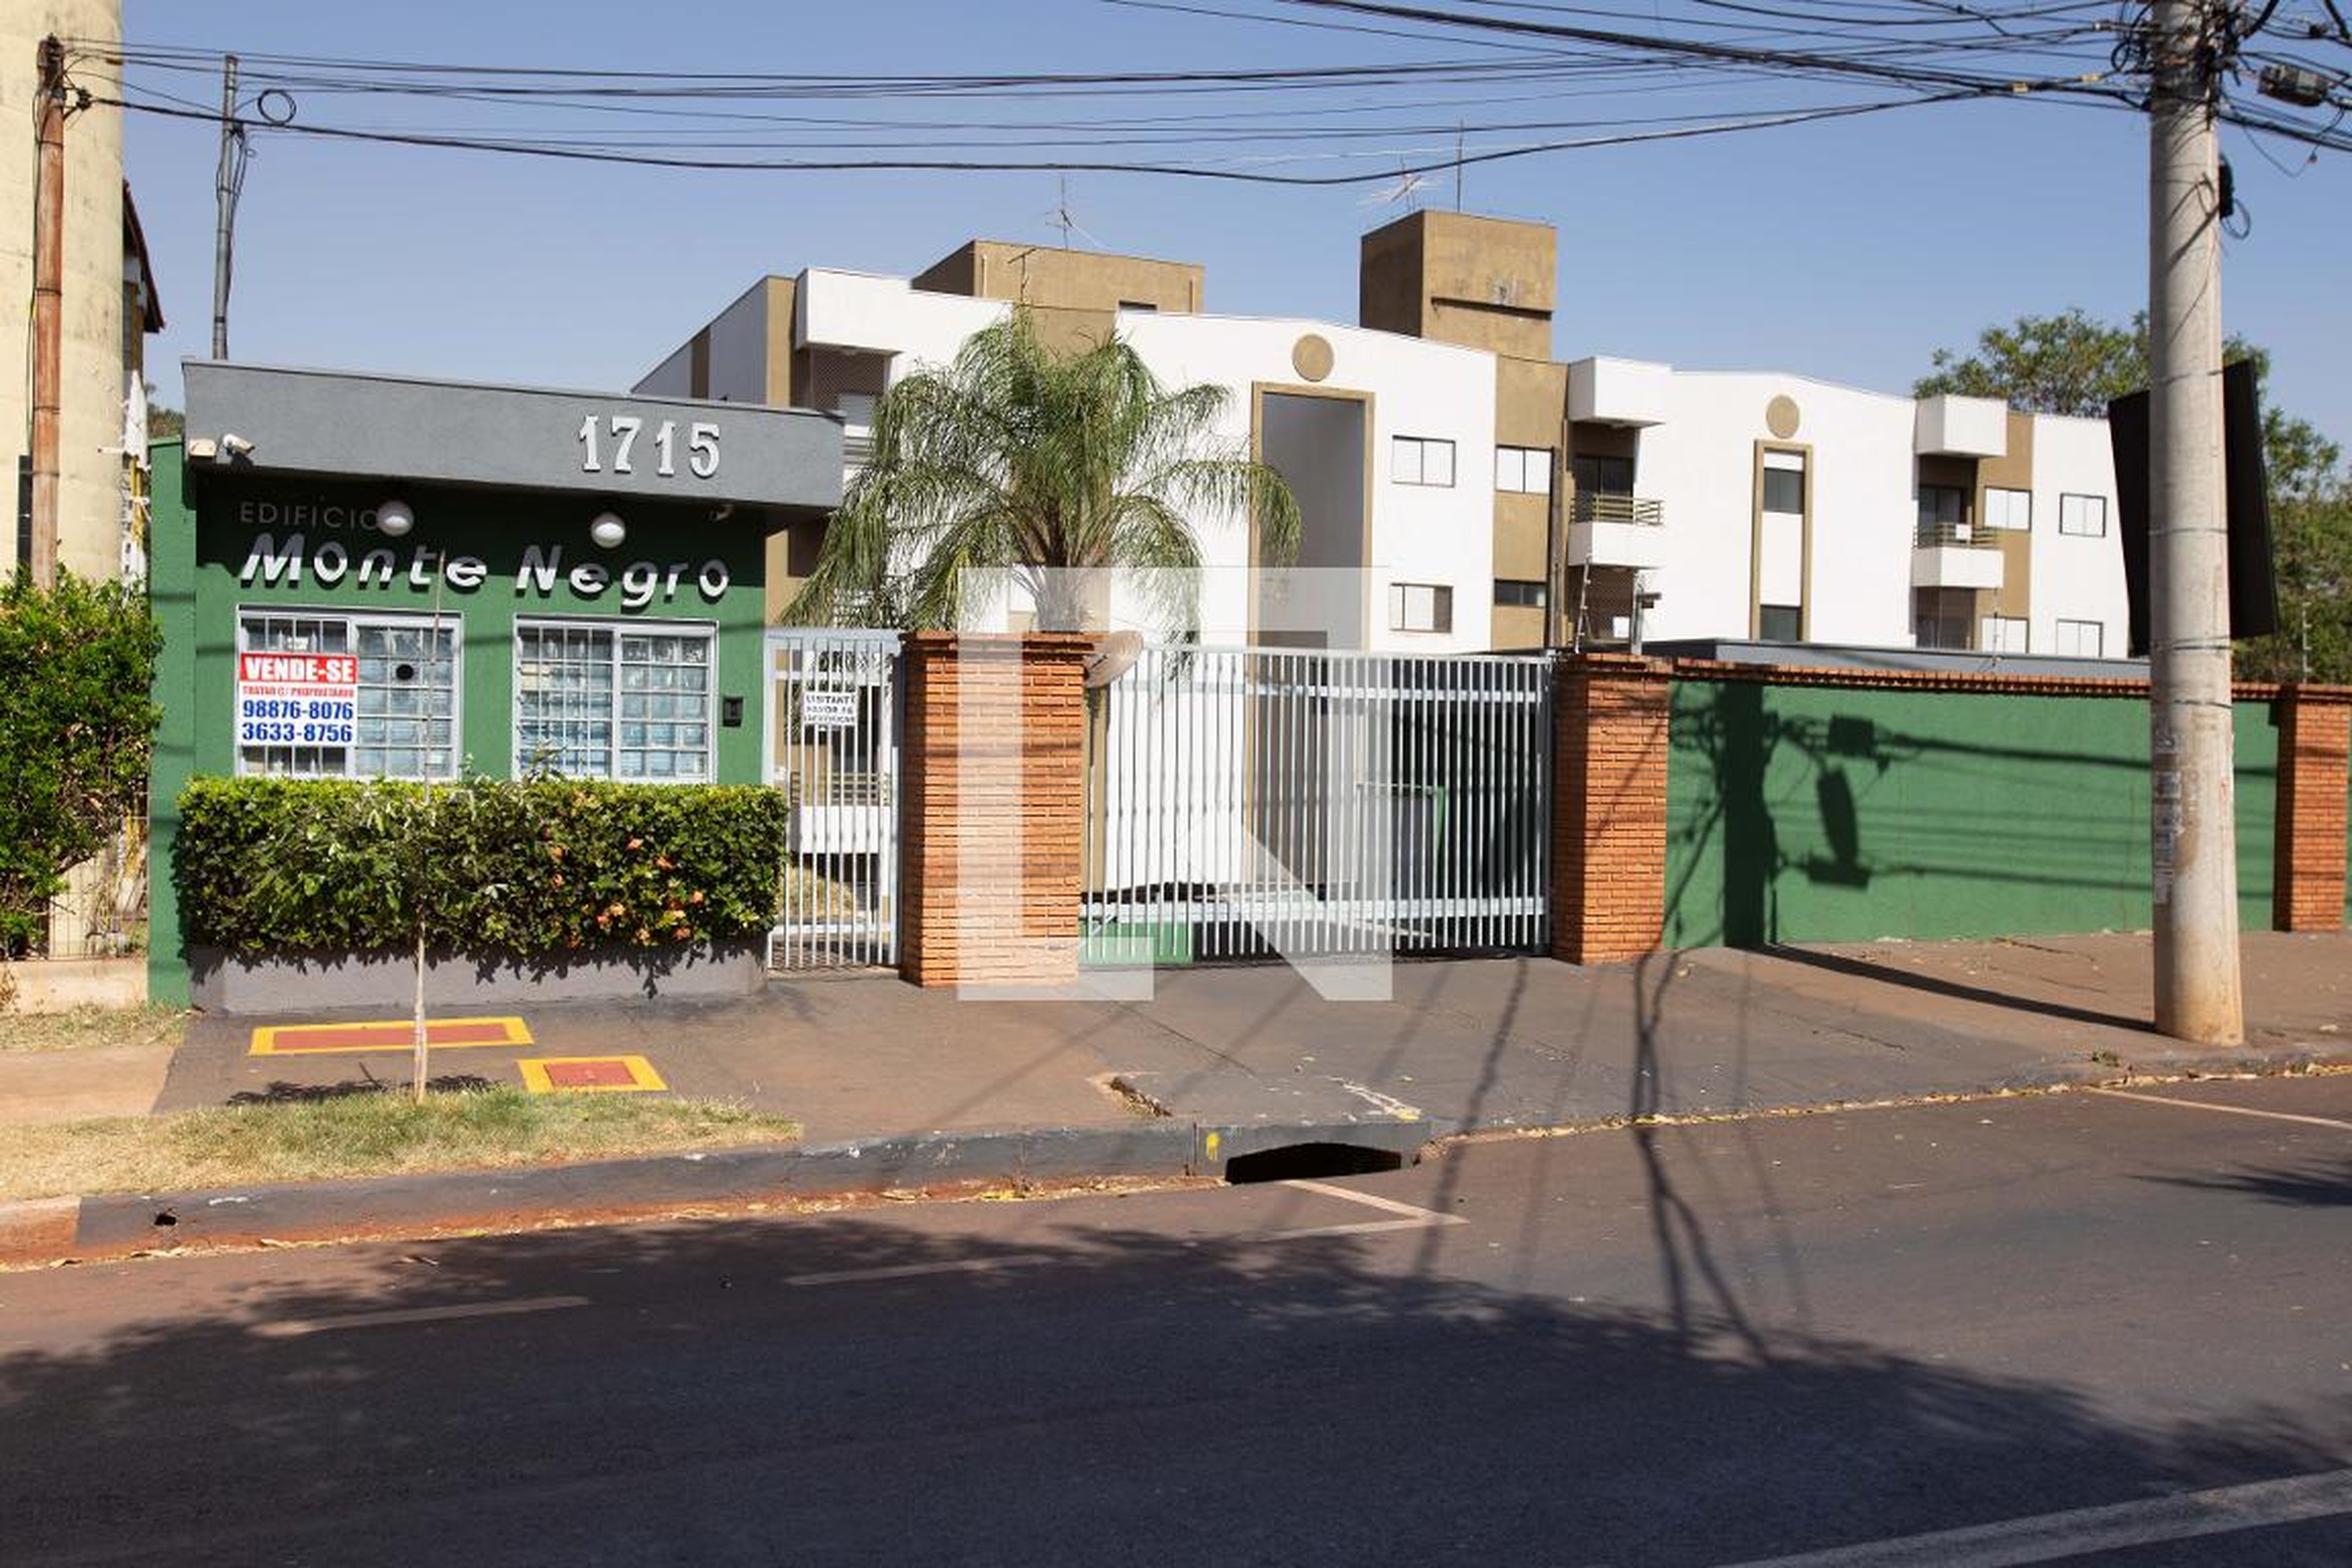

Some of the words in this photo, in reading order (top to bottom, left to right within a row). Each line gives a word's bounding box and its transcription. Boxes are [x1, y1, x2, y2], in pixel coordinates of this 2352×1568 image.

[579, 415, 720, 478] 1715
[241, 533, 488, 589] Monte
[516, 545, 729, 608] Negro
[245, 657, 353, 682] VENDE-SE
[243, 700, 353, 720] 98876-8076
[243, 722, 352, 742] 3633-8756
